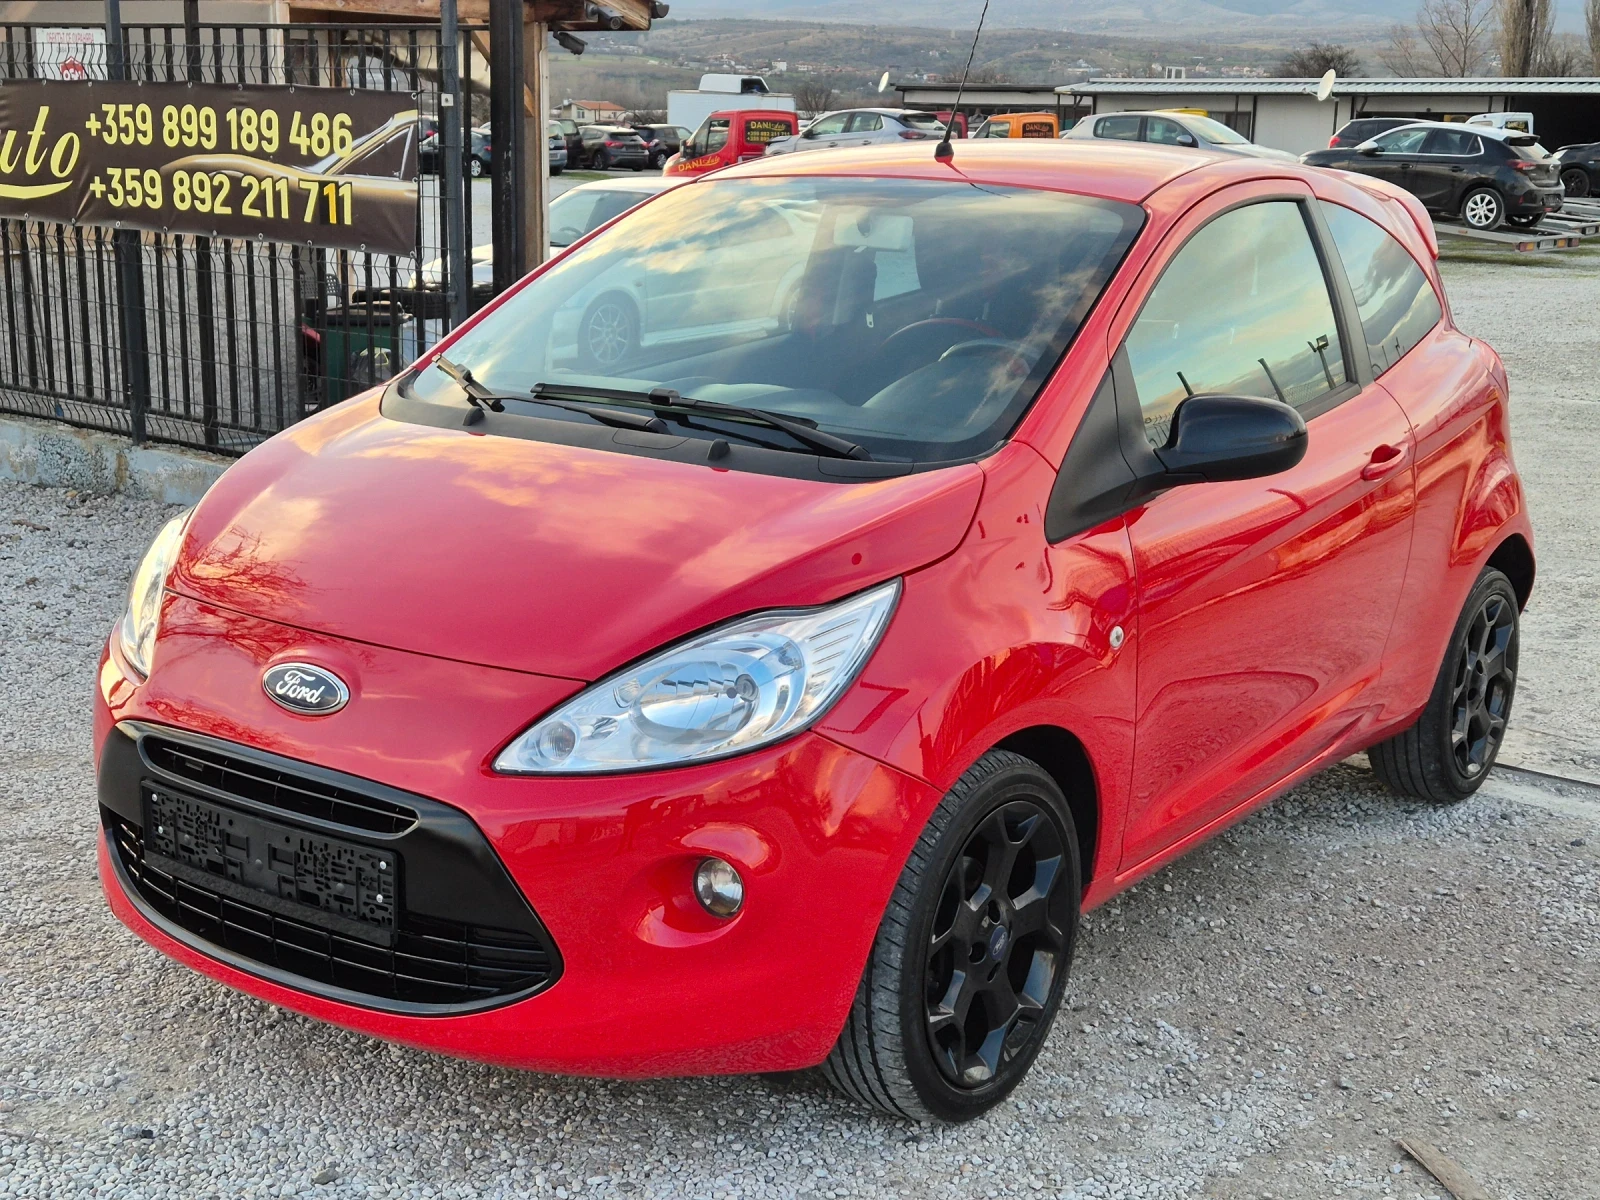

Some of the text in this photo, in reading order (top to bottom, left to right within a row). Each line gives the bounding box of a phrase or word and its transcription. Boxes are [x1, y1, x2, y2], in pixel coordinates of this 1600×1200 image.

[0, 106, 80, 178] uto
[85, 103, 352, 157] +359 899 189 486
[750, 121, 771, 129] DANI
[678, 158, 703, 172] DANI
[90, 167, 352, 225] +359 892 211 711
[275, 670, 325, 704] Ford
